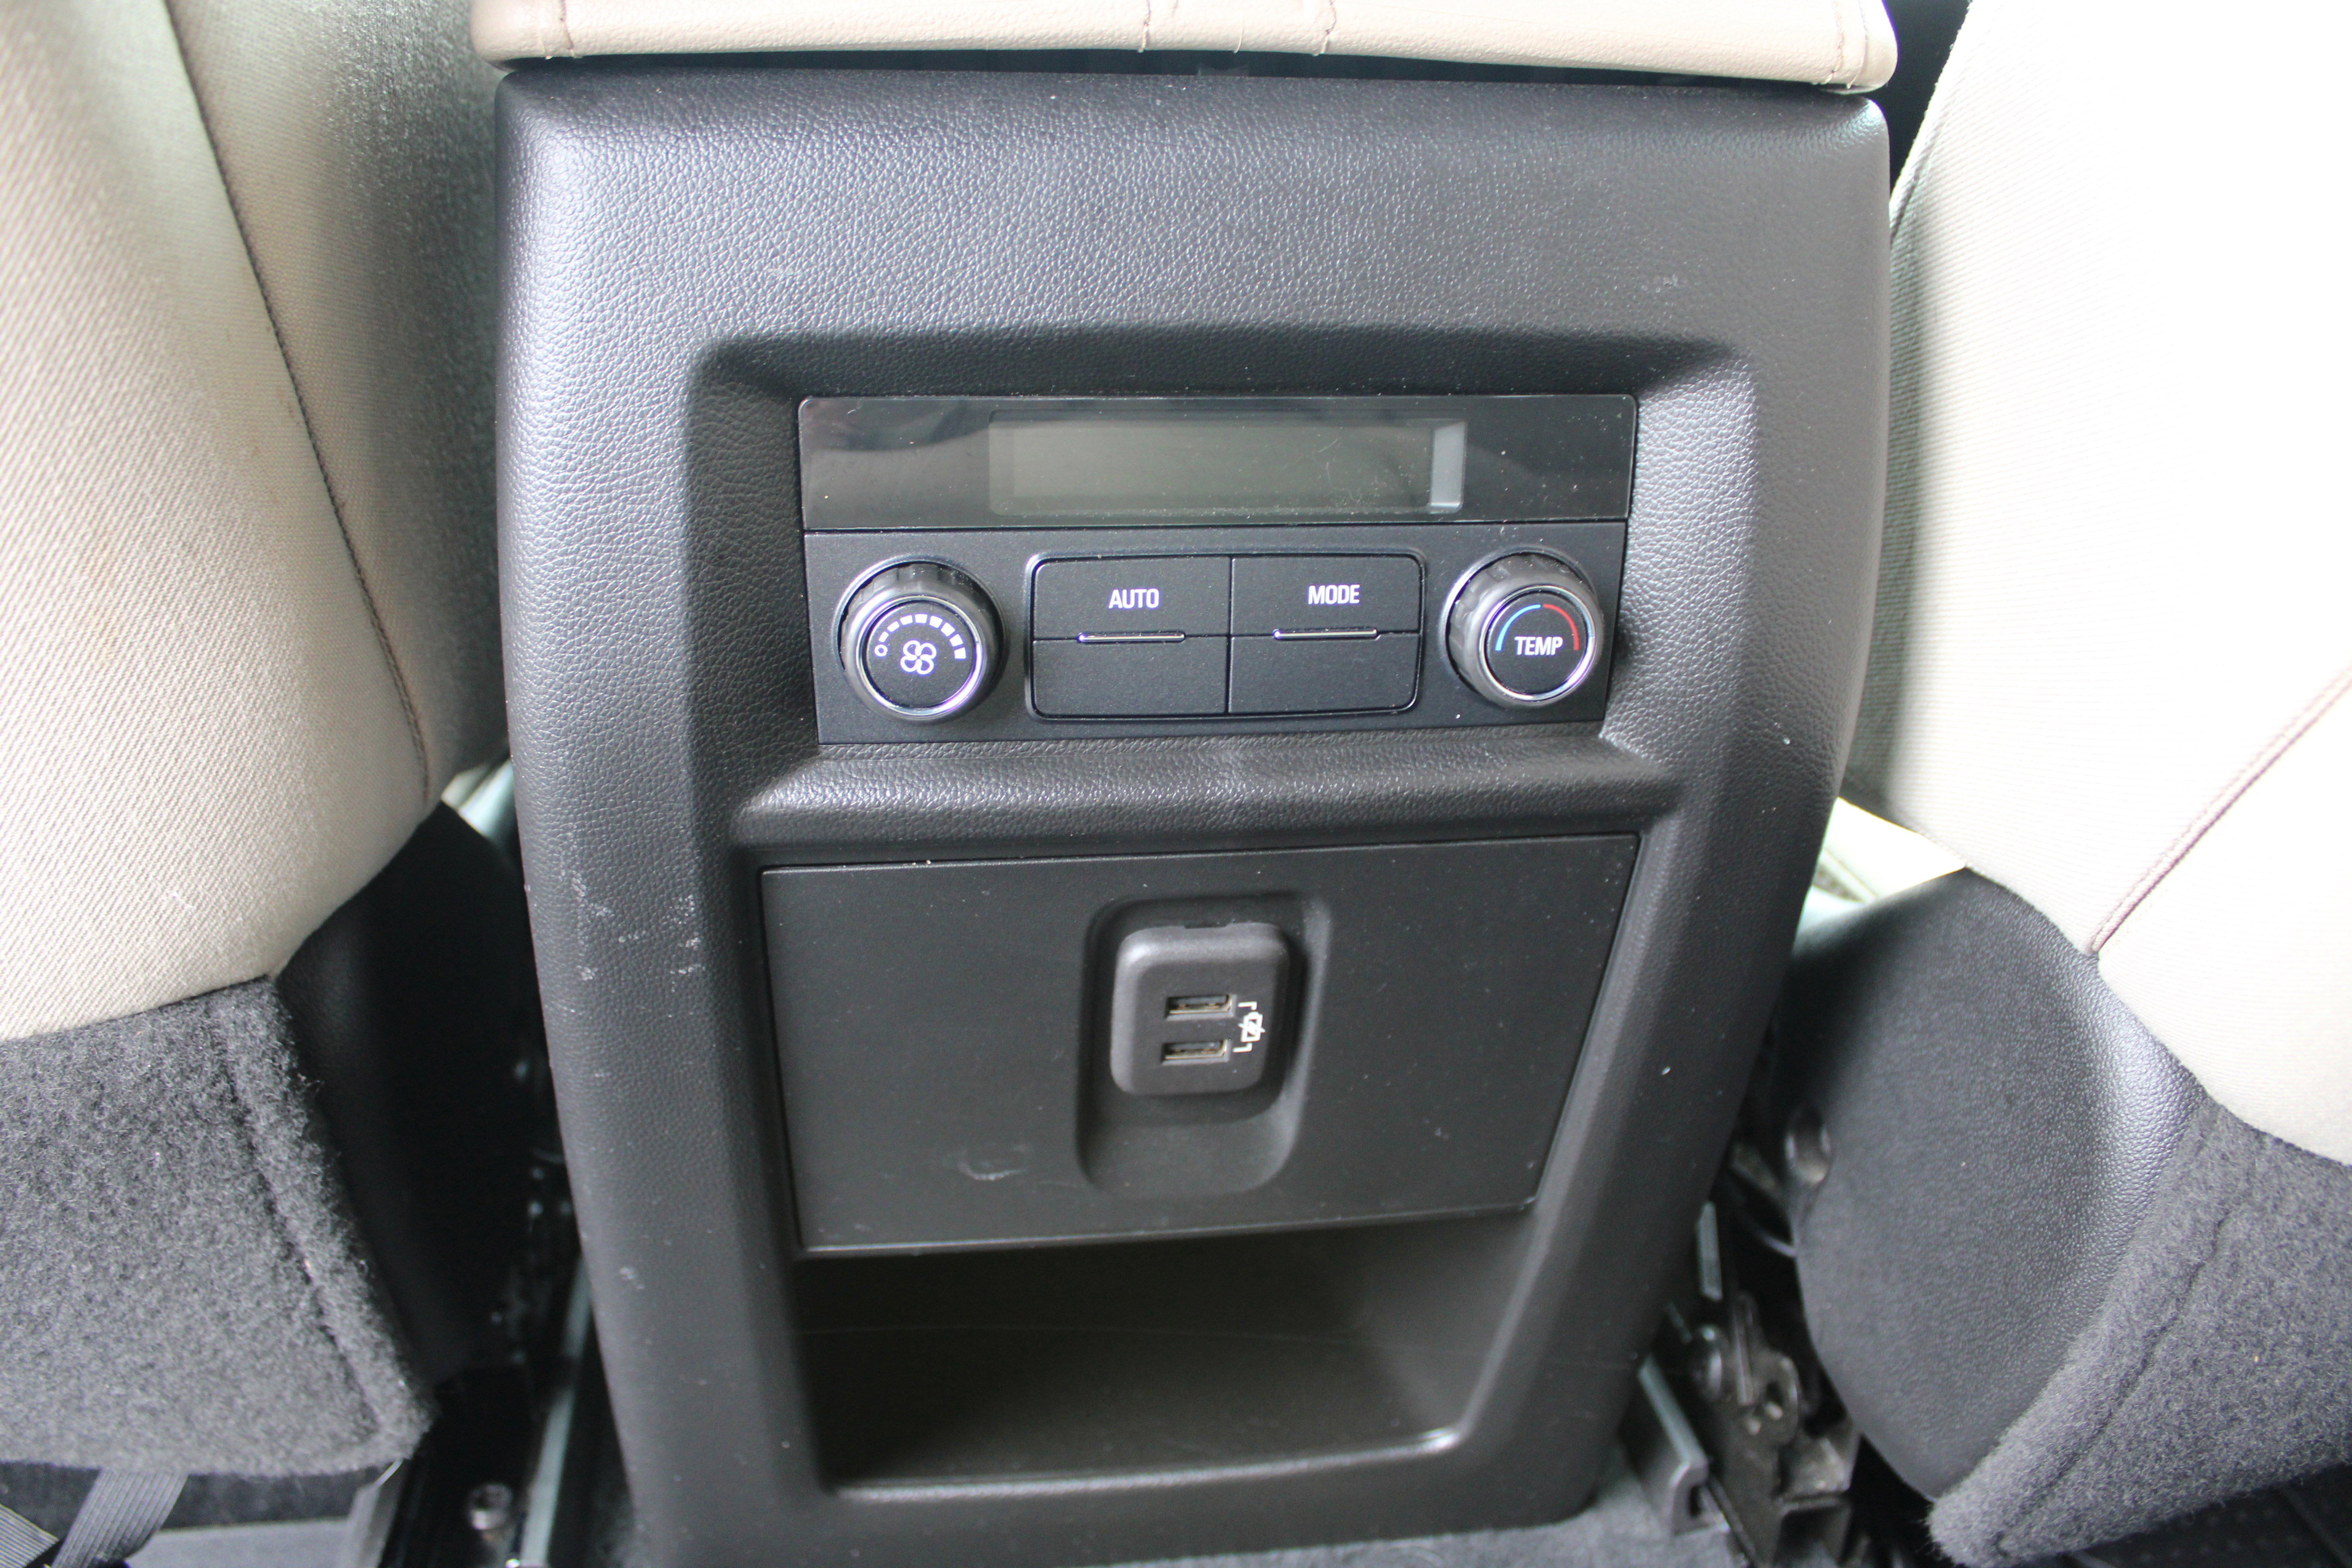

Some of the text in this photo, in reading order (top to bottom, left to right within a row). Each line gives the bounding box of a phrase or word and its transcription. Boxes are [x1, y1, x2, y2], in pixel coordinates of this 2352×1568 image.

[1108, 588, 1159, 609] AUTO
[1308, 584, 1360, 604] MODE
[1514, 636, 1563, 655] TEMP
